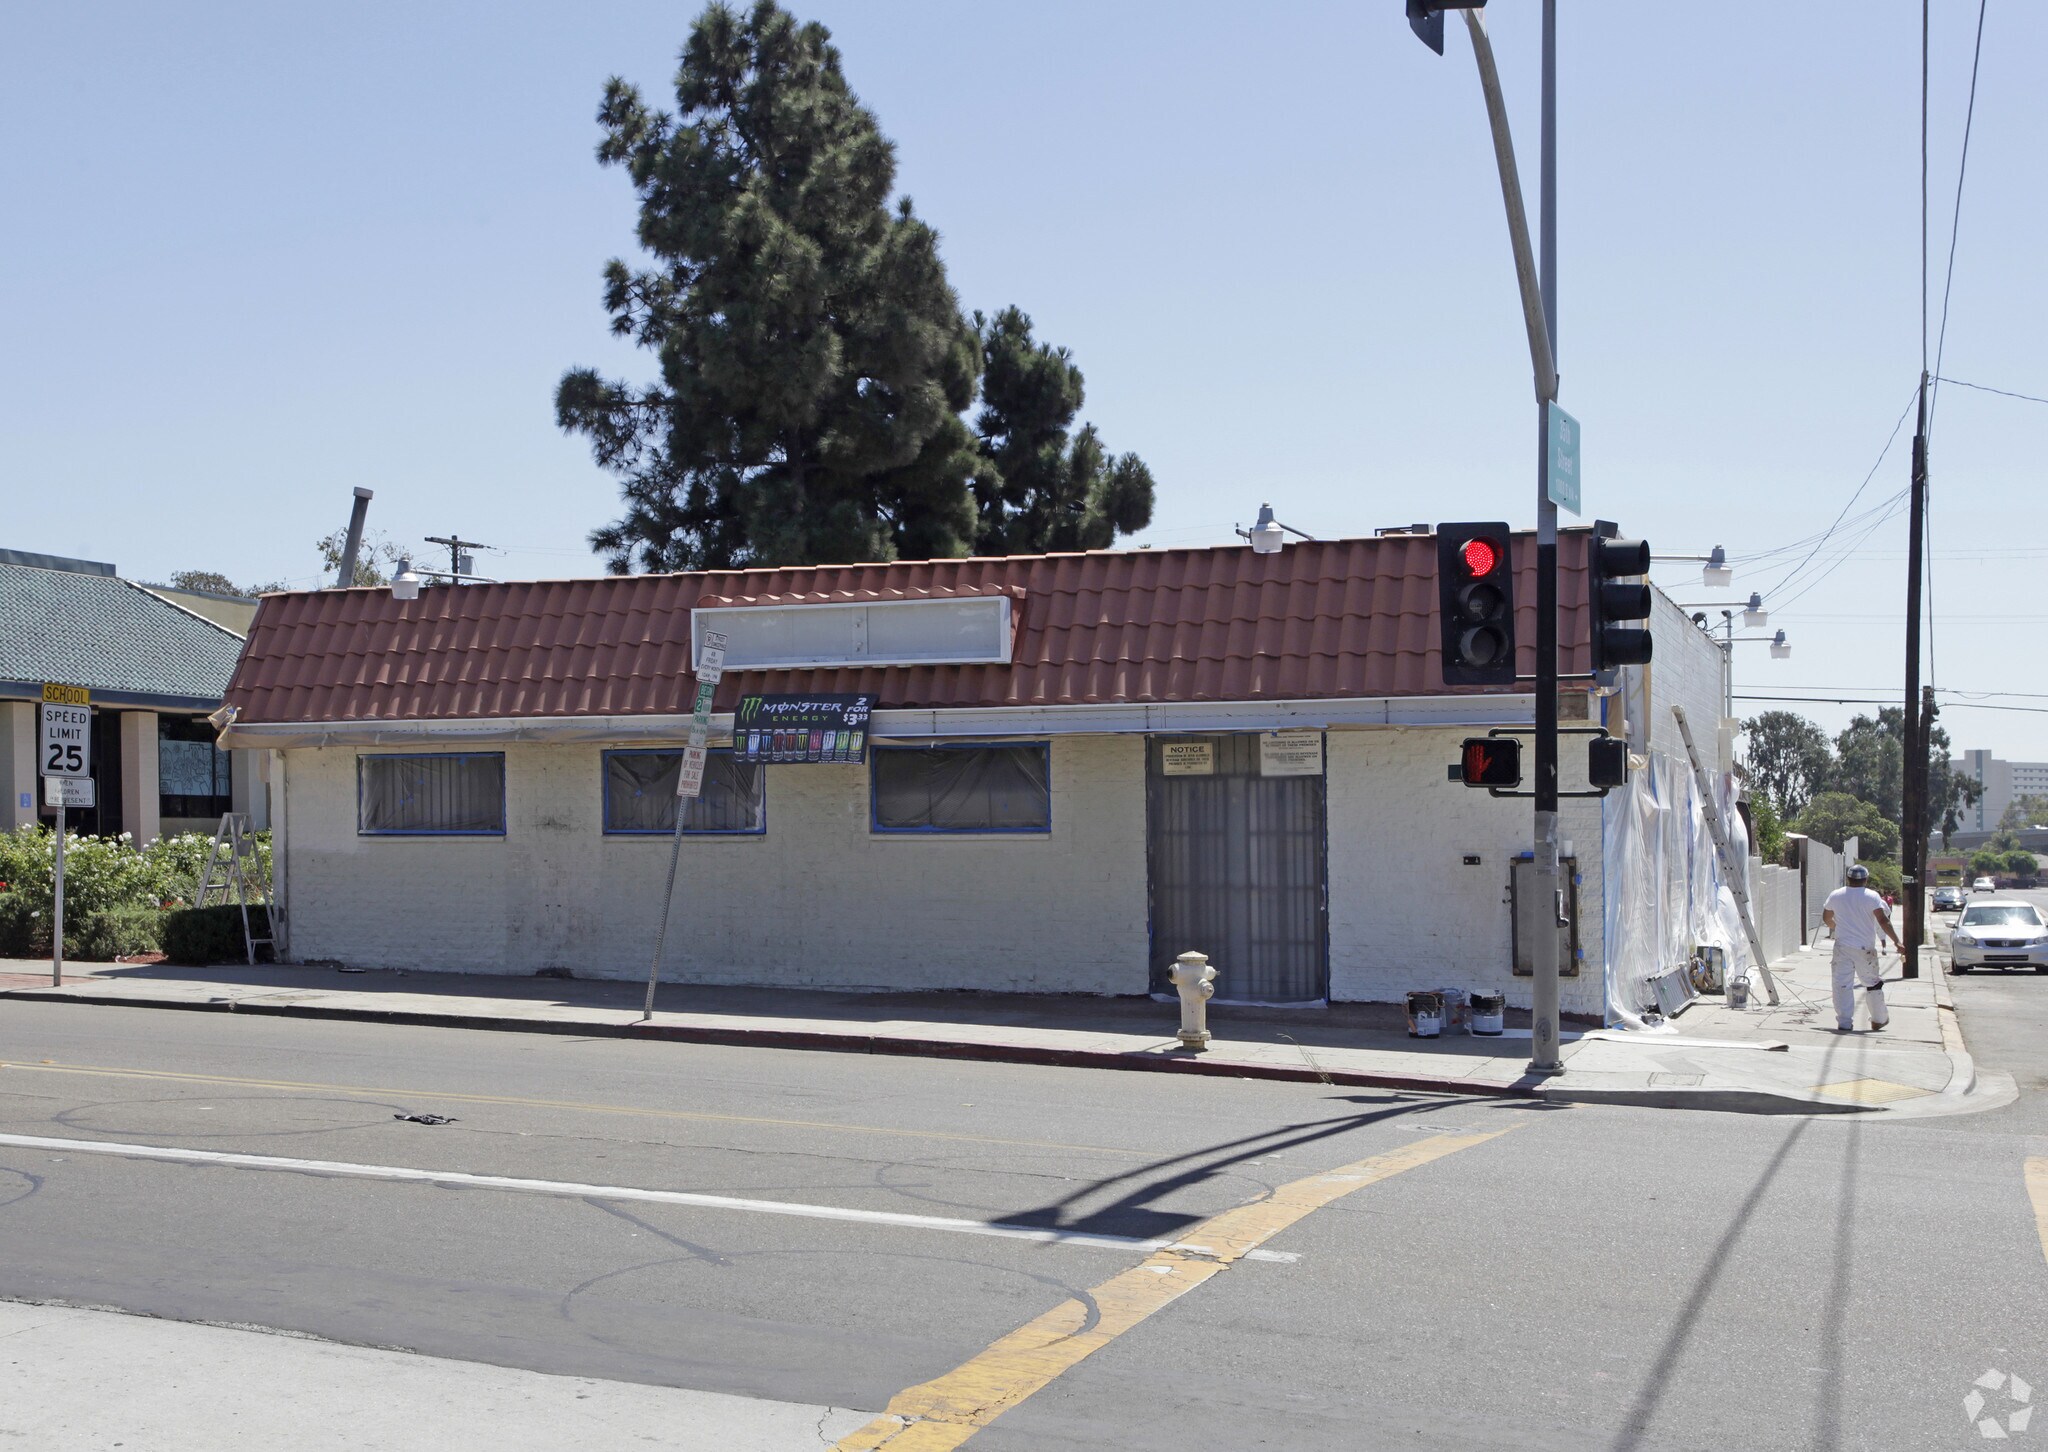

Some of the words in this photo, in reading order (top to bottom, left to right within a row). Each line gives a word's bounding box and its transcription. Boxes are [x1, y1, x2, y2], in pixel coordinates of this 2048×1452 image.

[45, 685, 87, 705] SCHOOL
[700, 684, 713, 696] BEGIN
[695, 699, 702, 711] 2
[761, 701, 843, 714] MONSTER
[855, 697, 867, 706] 2
[45, 710, 87, 724] SPEED
[49, 727, 82, 740] LIMIT
[1170, 745, 1205, 753] NOTICE
[47, 743, 83, 772] 25
